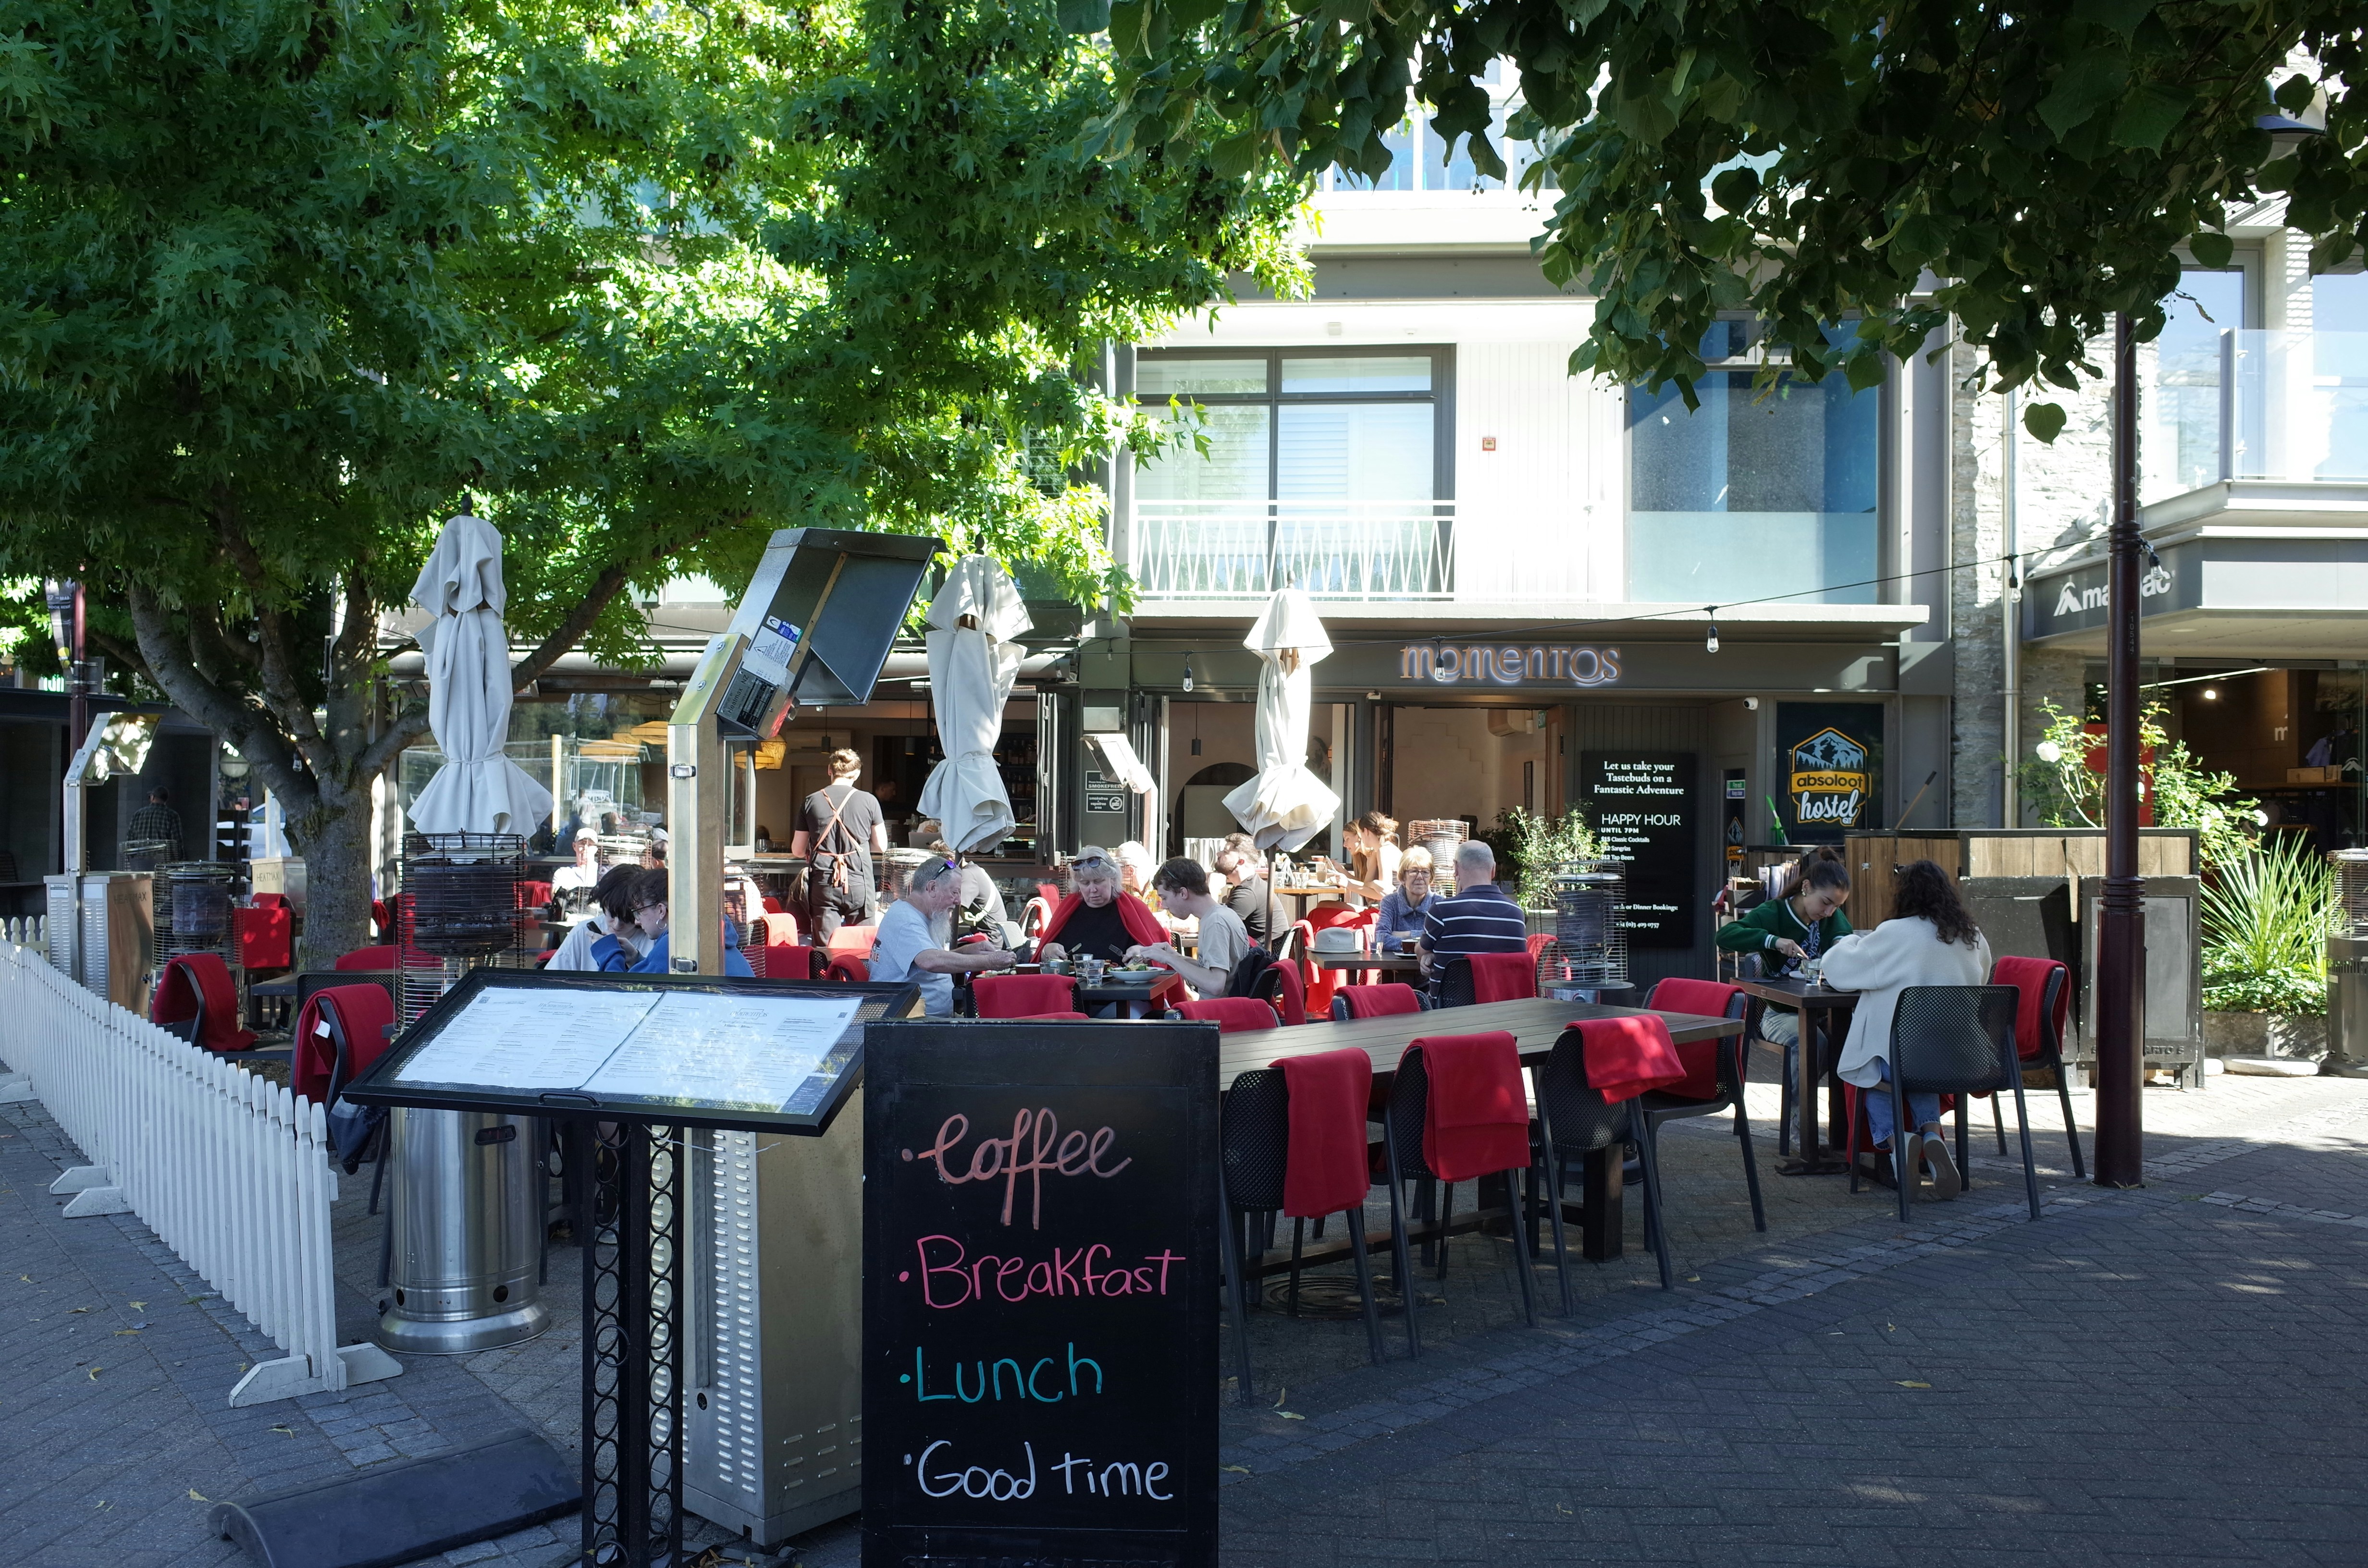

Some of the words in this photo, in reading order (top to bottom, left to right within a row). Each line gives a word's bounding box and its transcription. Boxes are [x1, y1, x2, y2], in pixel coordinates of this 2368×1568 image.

[1400, 646, 1621, 684] momentos
[727, 687, 743, 713] Heatmax
[740, 674, 749, 685] NZ
[1603, 760, 1619, 770] Let
[1633, 760, 1652, 771] take
[1653, 764, 1675, 773] your
[1606, 772, 1651, 782] Tastebuds
[1797, 774, 1863, 788] absoloot
[1593, 784, 1634, 794] Fantastic
[1636, 784, 1684, 795] Adventure
[1800, 789, 1859, 820] hostel
[1602, 813, 1641, 825] HAPPY
[1644, 814, 1681, 826] HOUR
[257, 871, 279, 882] HEATMAX
[113, 892, 147, 904] HEATMAX
[1653, 904, 1678, 912] Bookings:
[918, 1107, 1132, 1230] Coffee
[917, 1235, 1186, 1309] Breakfast
[917, 1342, 1103, 1403] Lunch
[918, 1440, 1036, 1501] Good
[1051, 1452, 1174, 1501] time
